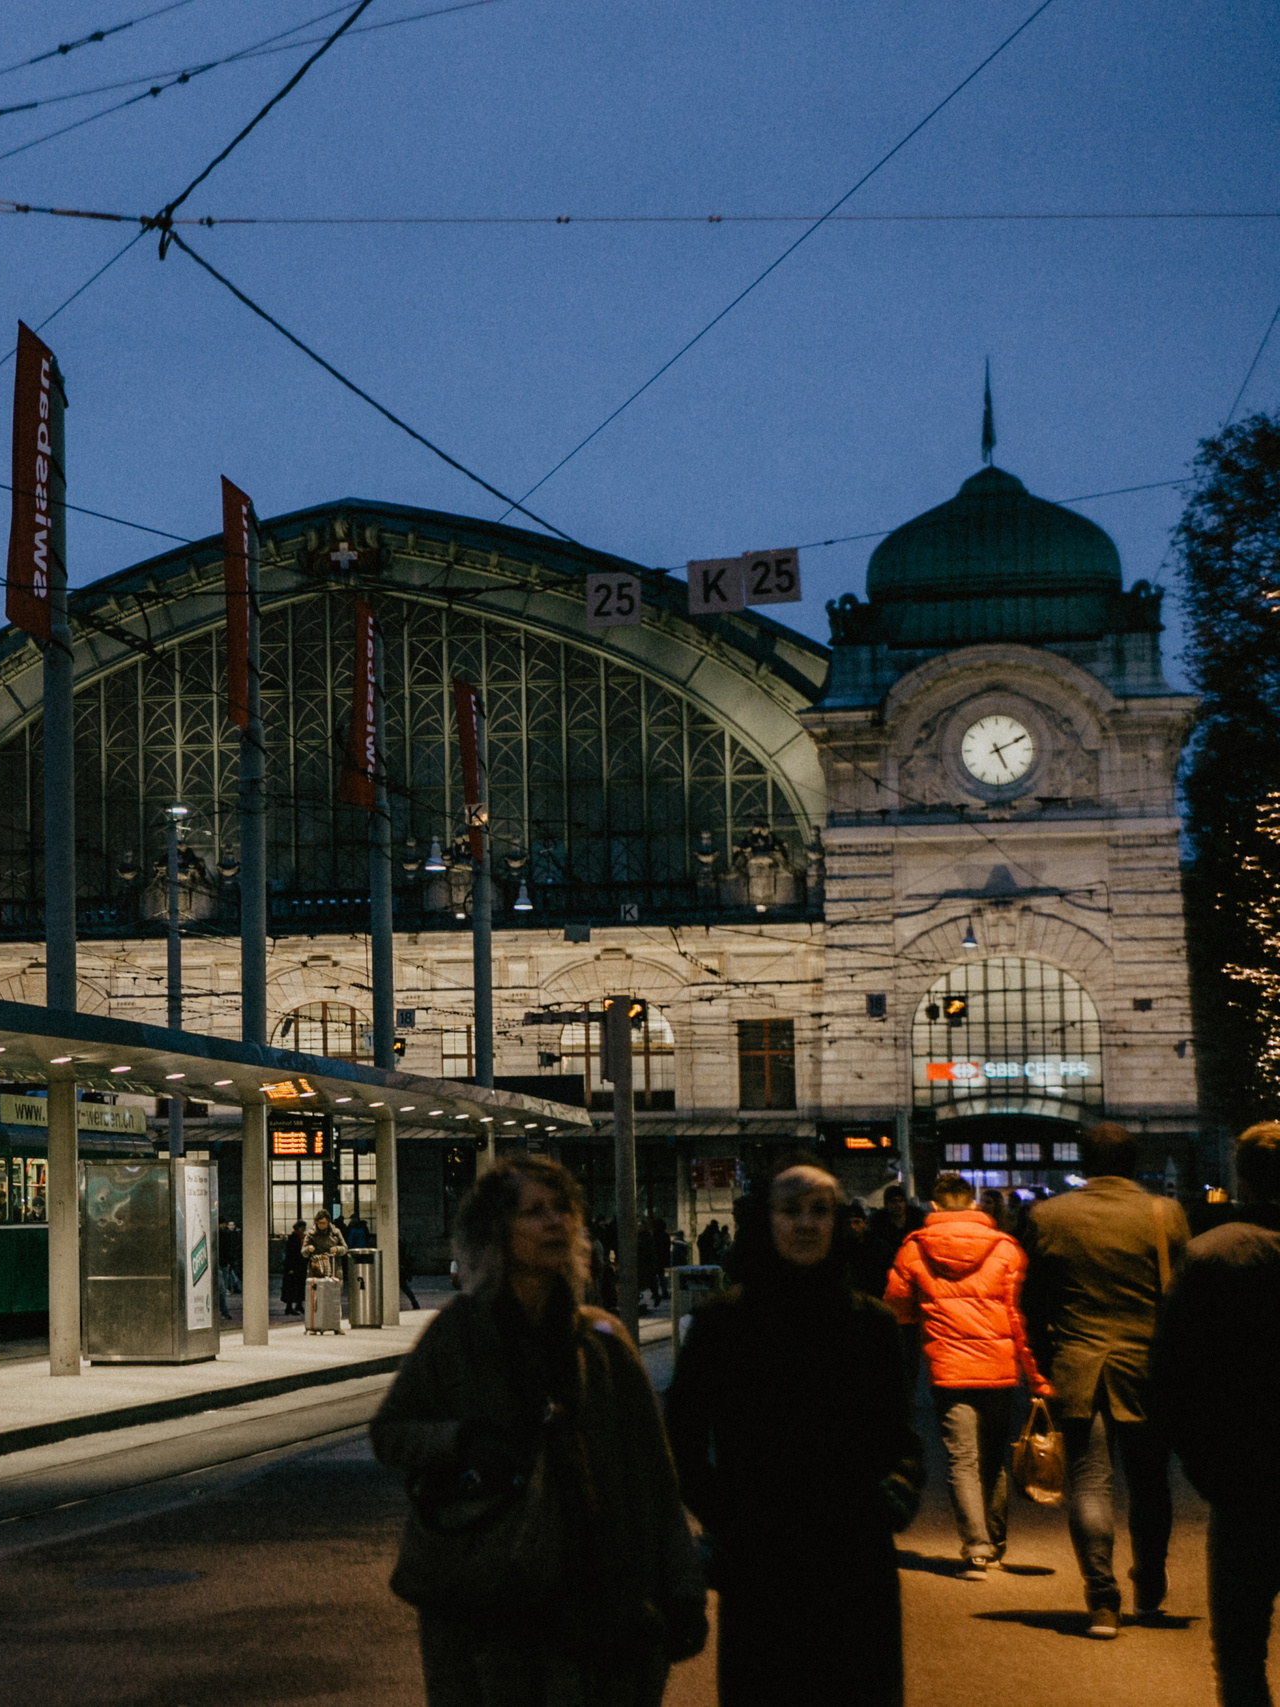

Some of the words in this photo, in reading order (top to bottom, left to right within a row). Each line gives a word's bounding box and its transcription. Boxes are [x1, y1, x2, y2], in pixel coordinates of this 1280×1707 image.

[703, 568, 727, 603] K
[751, 558, 795, 595] 25
[593, 582, 634, 617] 25
[468, 805, 484, 824] K
[624, 906, 635, 920] K
[400, 1012, 412, 1024] 18
[984, 1062, 1019, 1078] SBB
[1024, 1062, 1055, 1078] CFF
[1059, 1061, 1090, 1077] FFS
